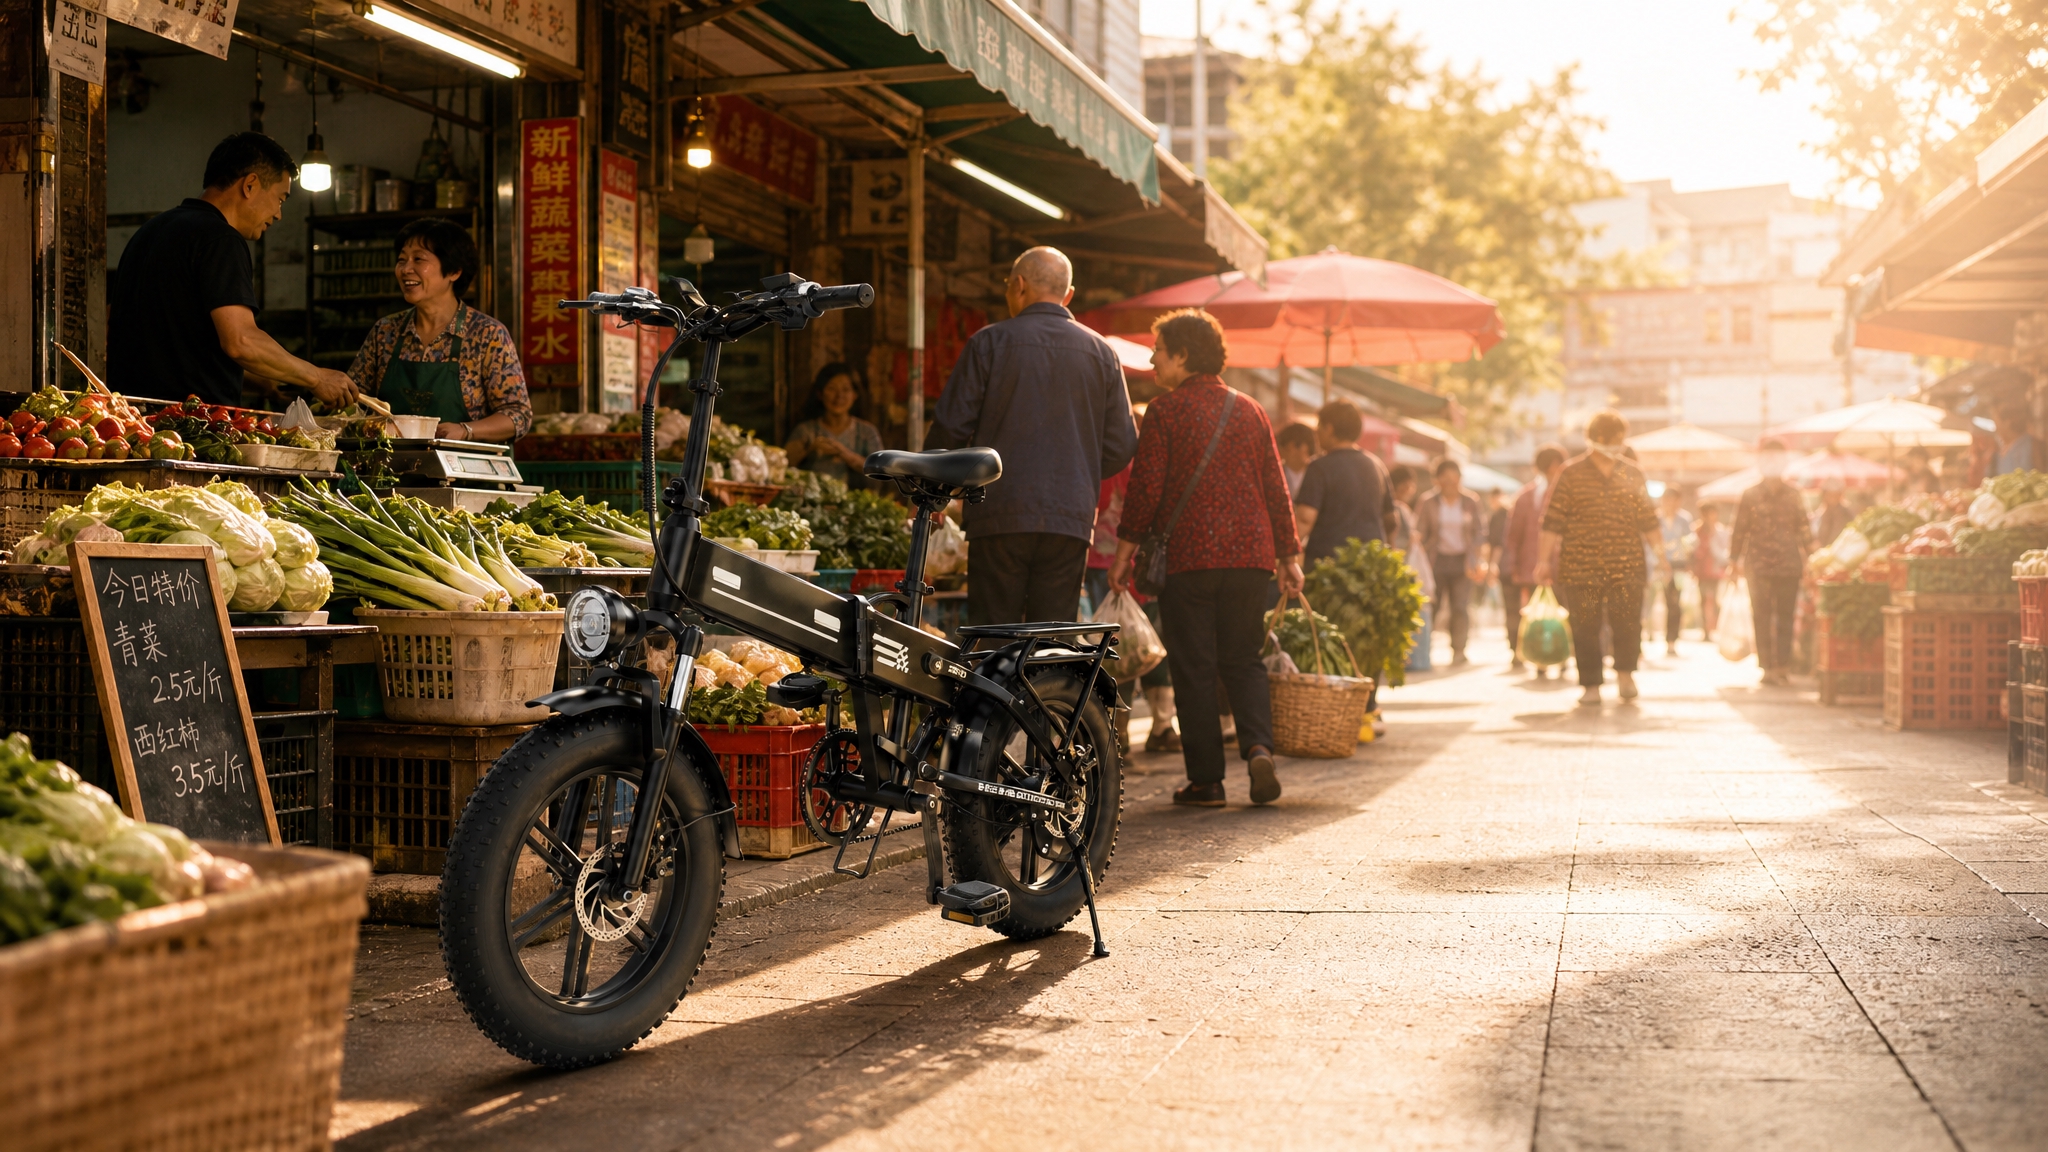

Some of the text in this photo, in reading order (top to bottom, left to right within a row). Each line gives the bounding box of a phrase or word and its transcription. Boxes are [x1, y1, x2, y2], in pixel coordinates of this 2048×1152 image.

[102, 567, 200, 609] 今日特价
[113, 619, 168, 667] 青菜
[150, 660, 223, 703] 2.5元/斤
[134, 717, 200, 758] 西红柿
[171, 750, 246, 798] 3.5元/斤
